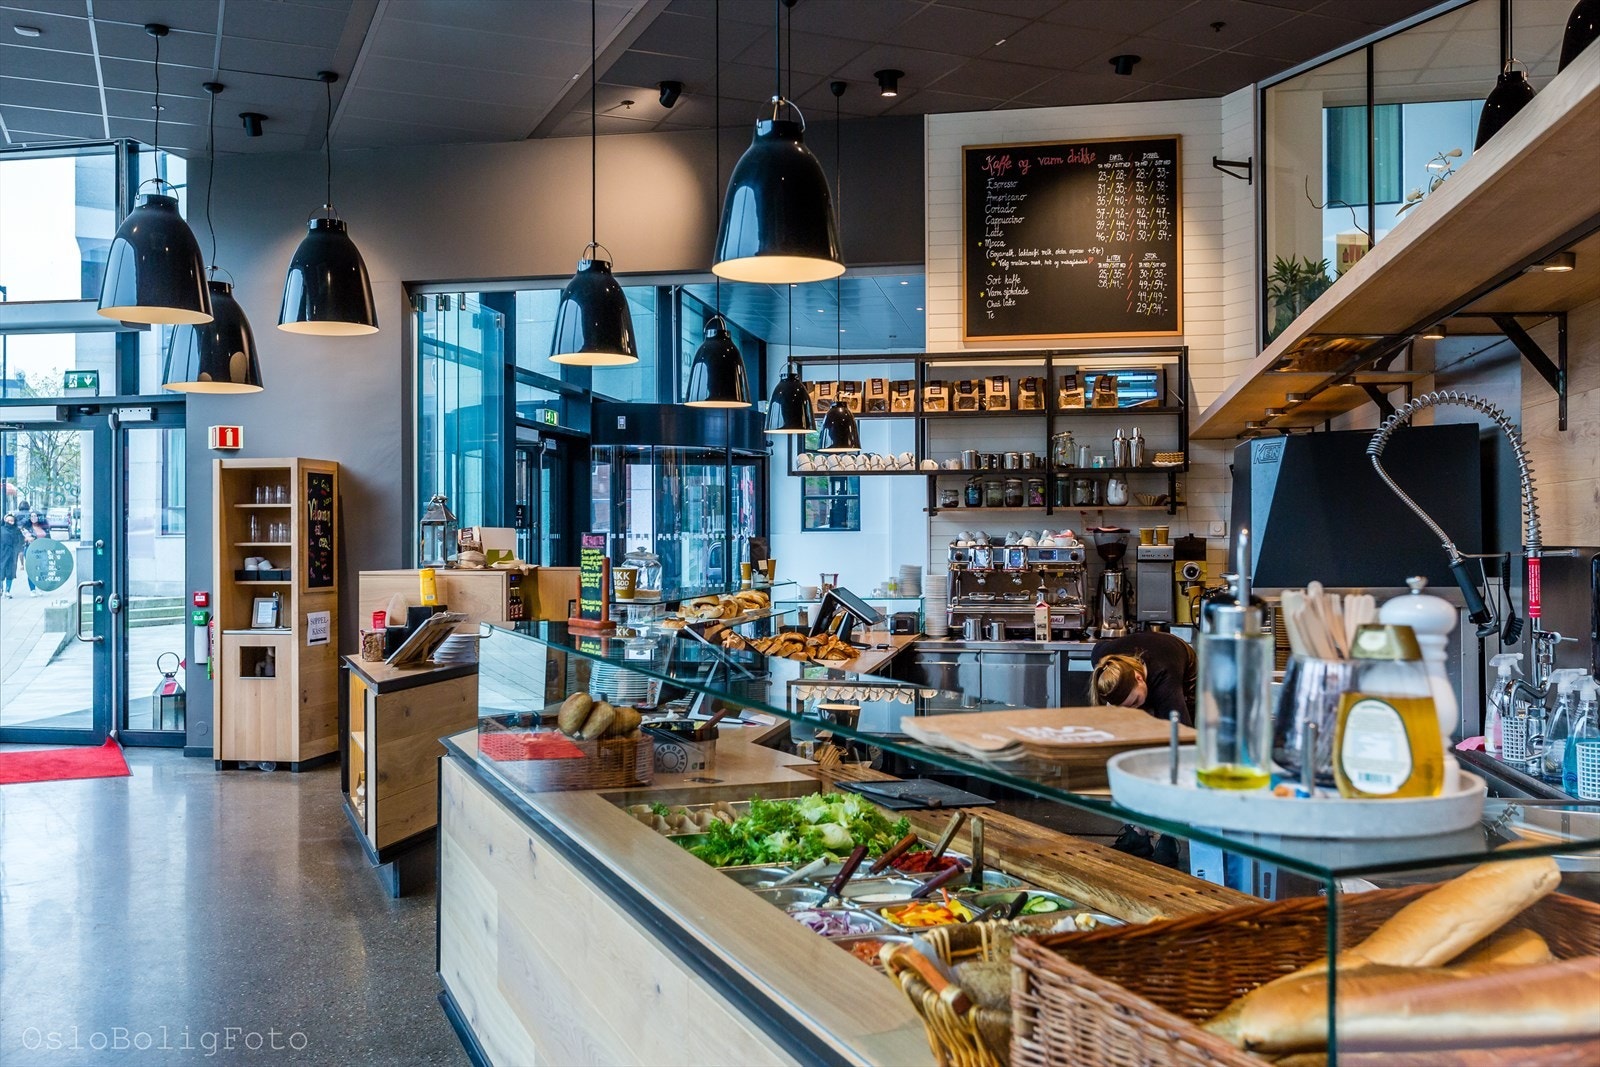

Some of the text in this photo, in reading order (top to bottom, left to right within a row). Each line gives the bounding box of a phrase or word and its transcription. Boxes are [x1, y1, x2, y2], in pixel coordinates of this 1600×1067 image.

[982, 147, 1096, 176] Kaffe og varm drikke
[986, 178, 1018, 190] Espresso
[986, 191, 1027, 202] Americano
[985, 202, 1017, 214] Cortado
[985, 215, 1025, 228] Cappuccino
[985, 226, 1004, 237] Latte
[985, 239, 1006, 248] Mocca
[986, 274, 1021, 288] Sort kaffe
[986, 287, 1029, 299] Varm sjokolade
[986, 300, 1001, 308] Chai
[986, 310, 995, 319] Te
